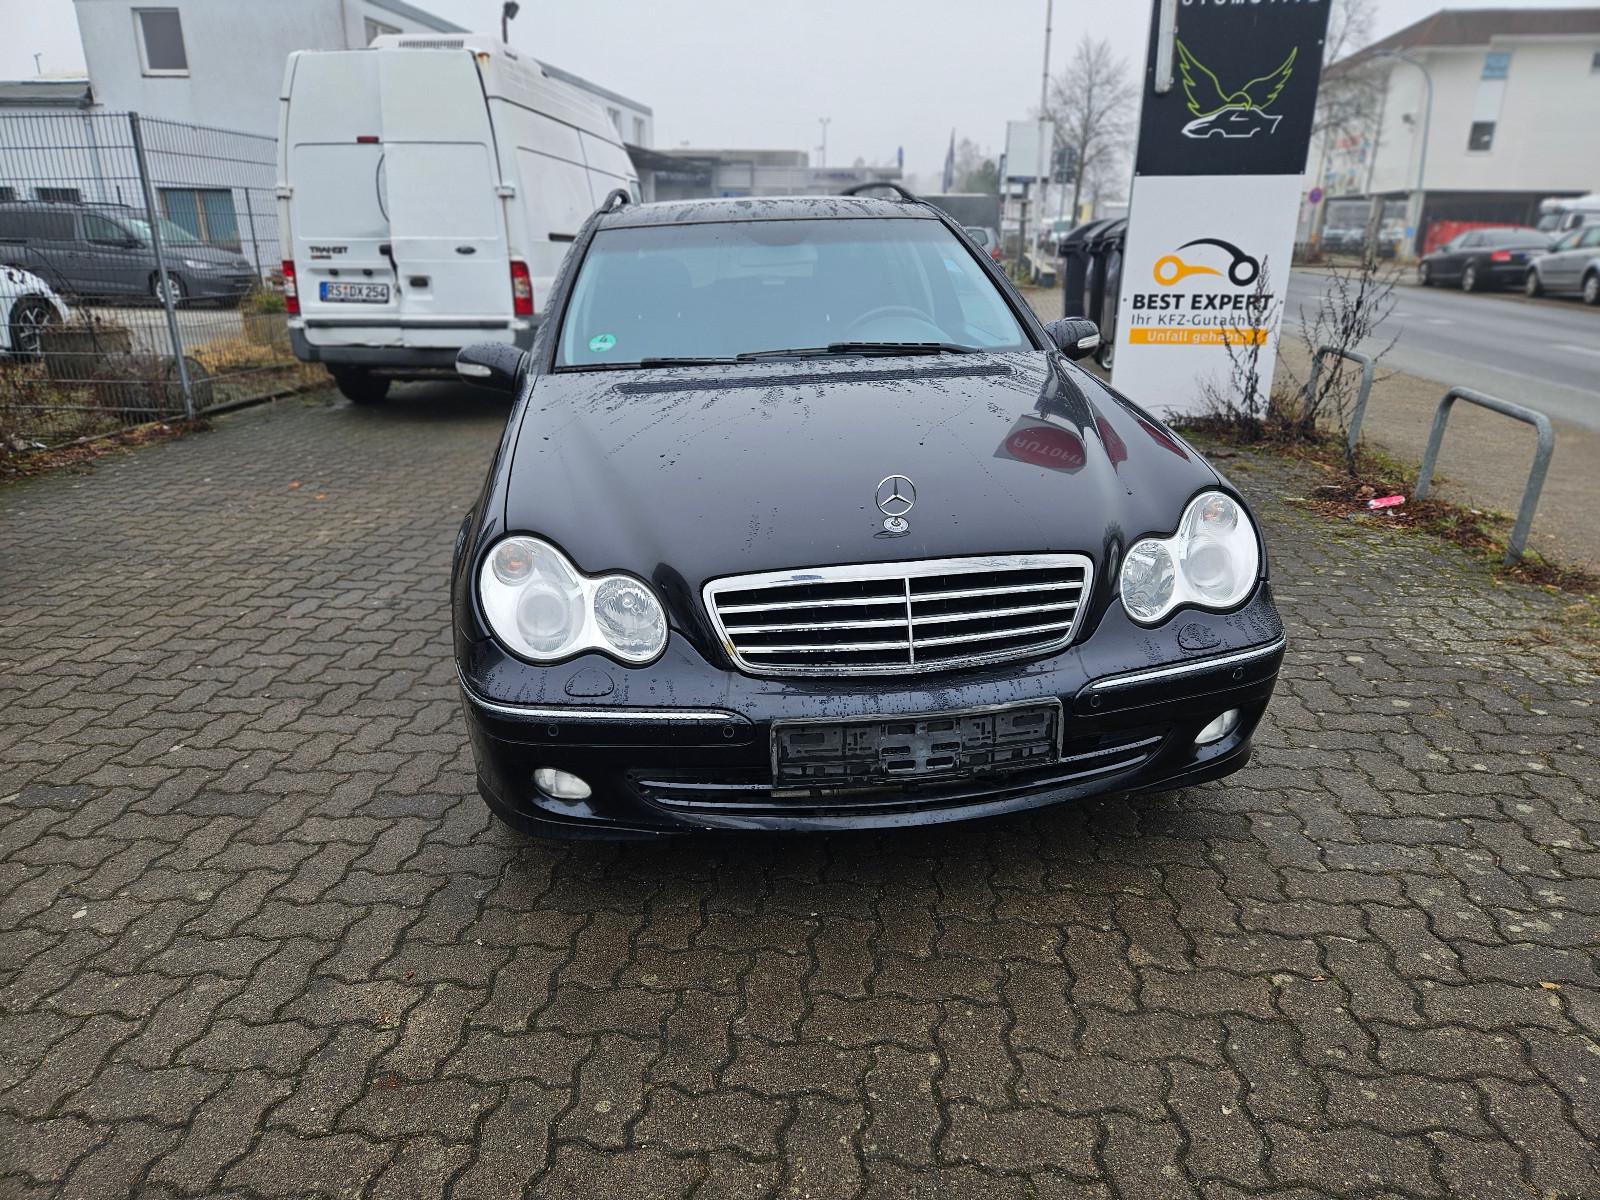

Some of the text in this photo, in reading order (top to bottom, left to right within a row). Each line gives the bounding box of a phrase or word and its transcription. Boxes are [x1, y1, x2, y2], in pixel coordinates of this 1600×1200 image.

[328, 285, 386, 298] RS DX 254
[1132, 294, 1274, 310] BEST EXPERT
[1131, 313, 1152, 325] Ihr
[1147, 331, 1187, 342] Unfall
